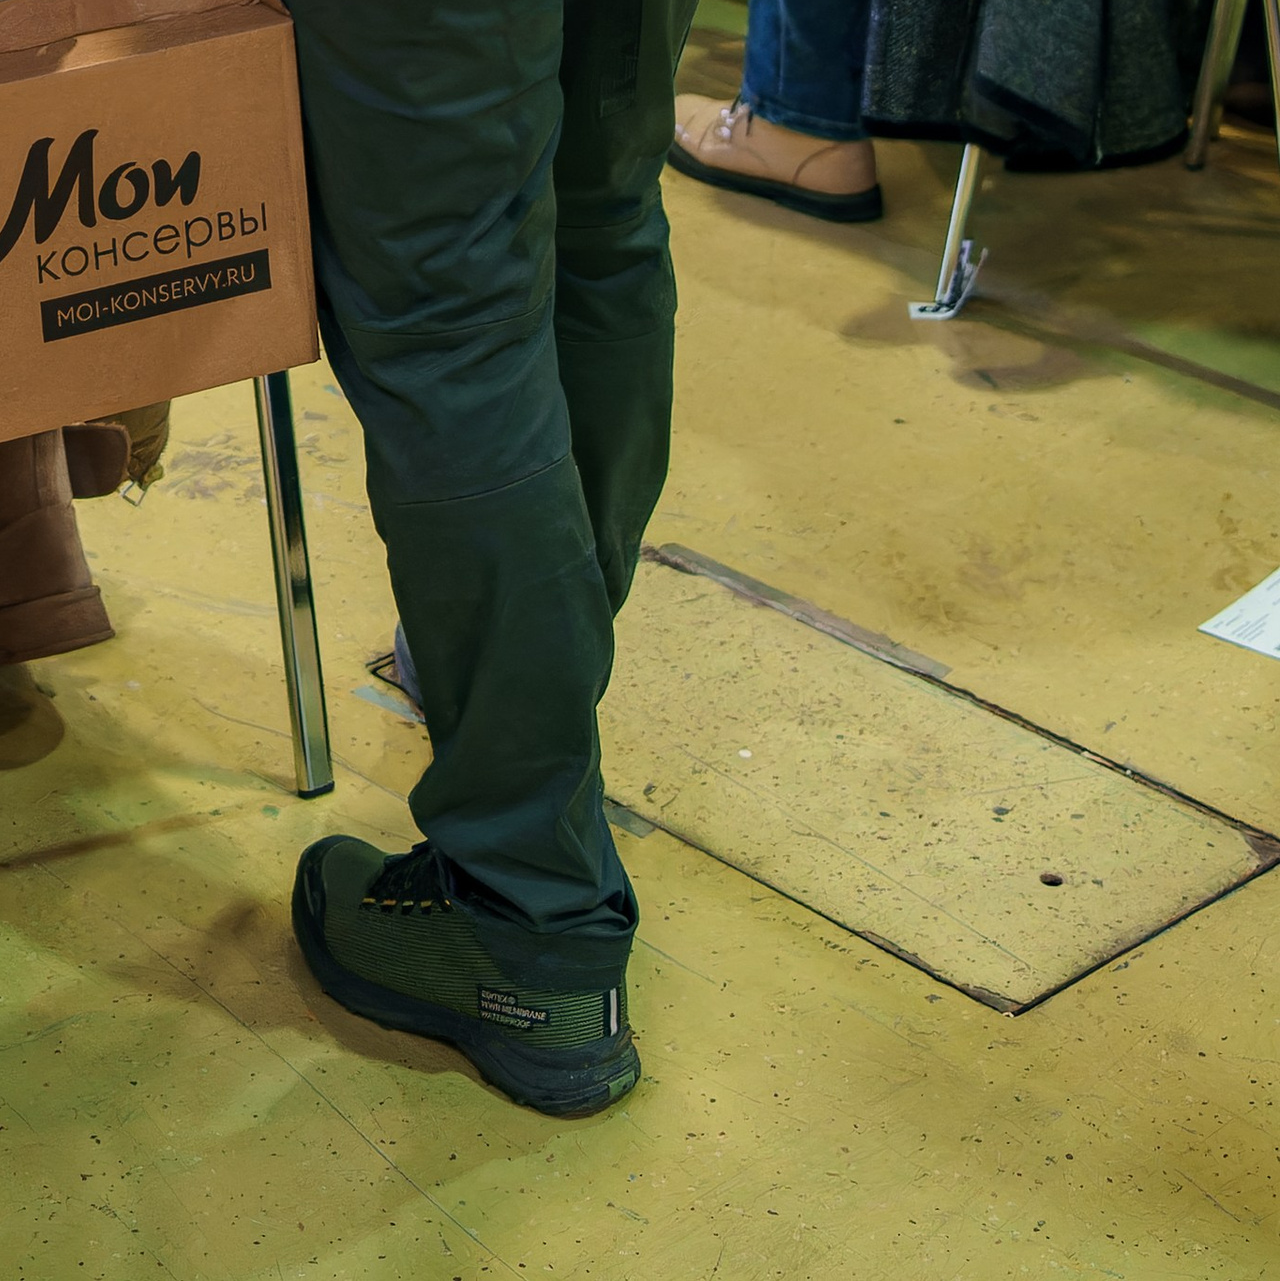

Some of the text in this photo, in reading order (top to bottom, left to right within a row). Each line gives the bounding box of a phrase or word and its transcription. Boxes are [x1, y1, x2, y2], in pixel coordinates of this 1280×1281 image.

[4, 129, 202, 245] Мои
[36, 202, 269, 285] консервы
[56, 263, 256, 328] MOI-KONSERVY.RU
